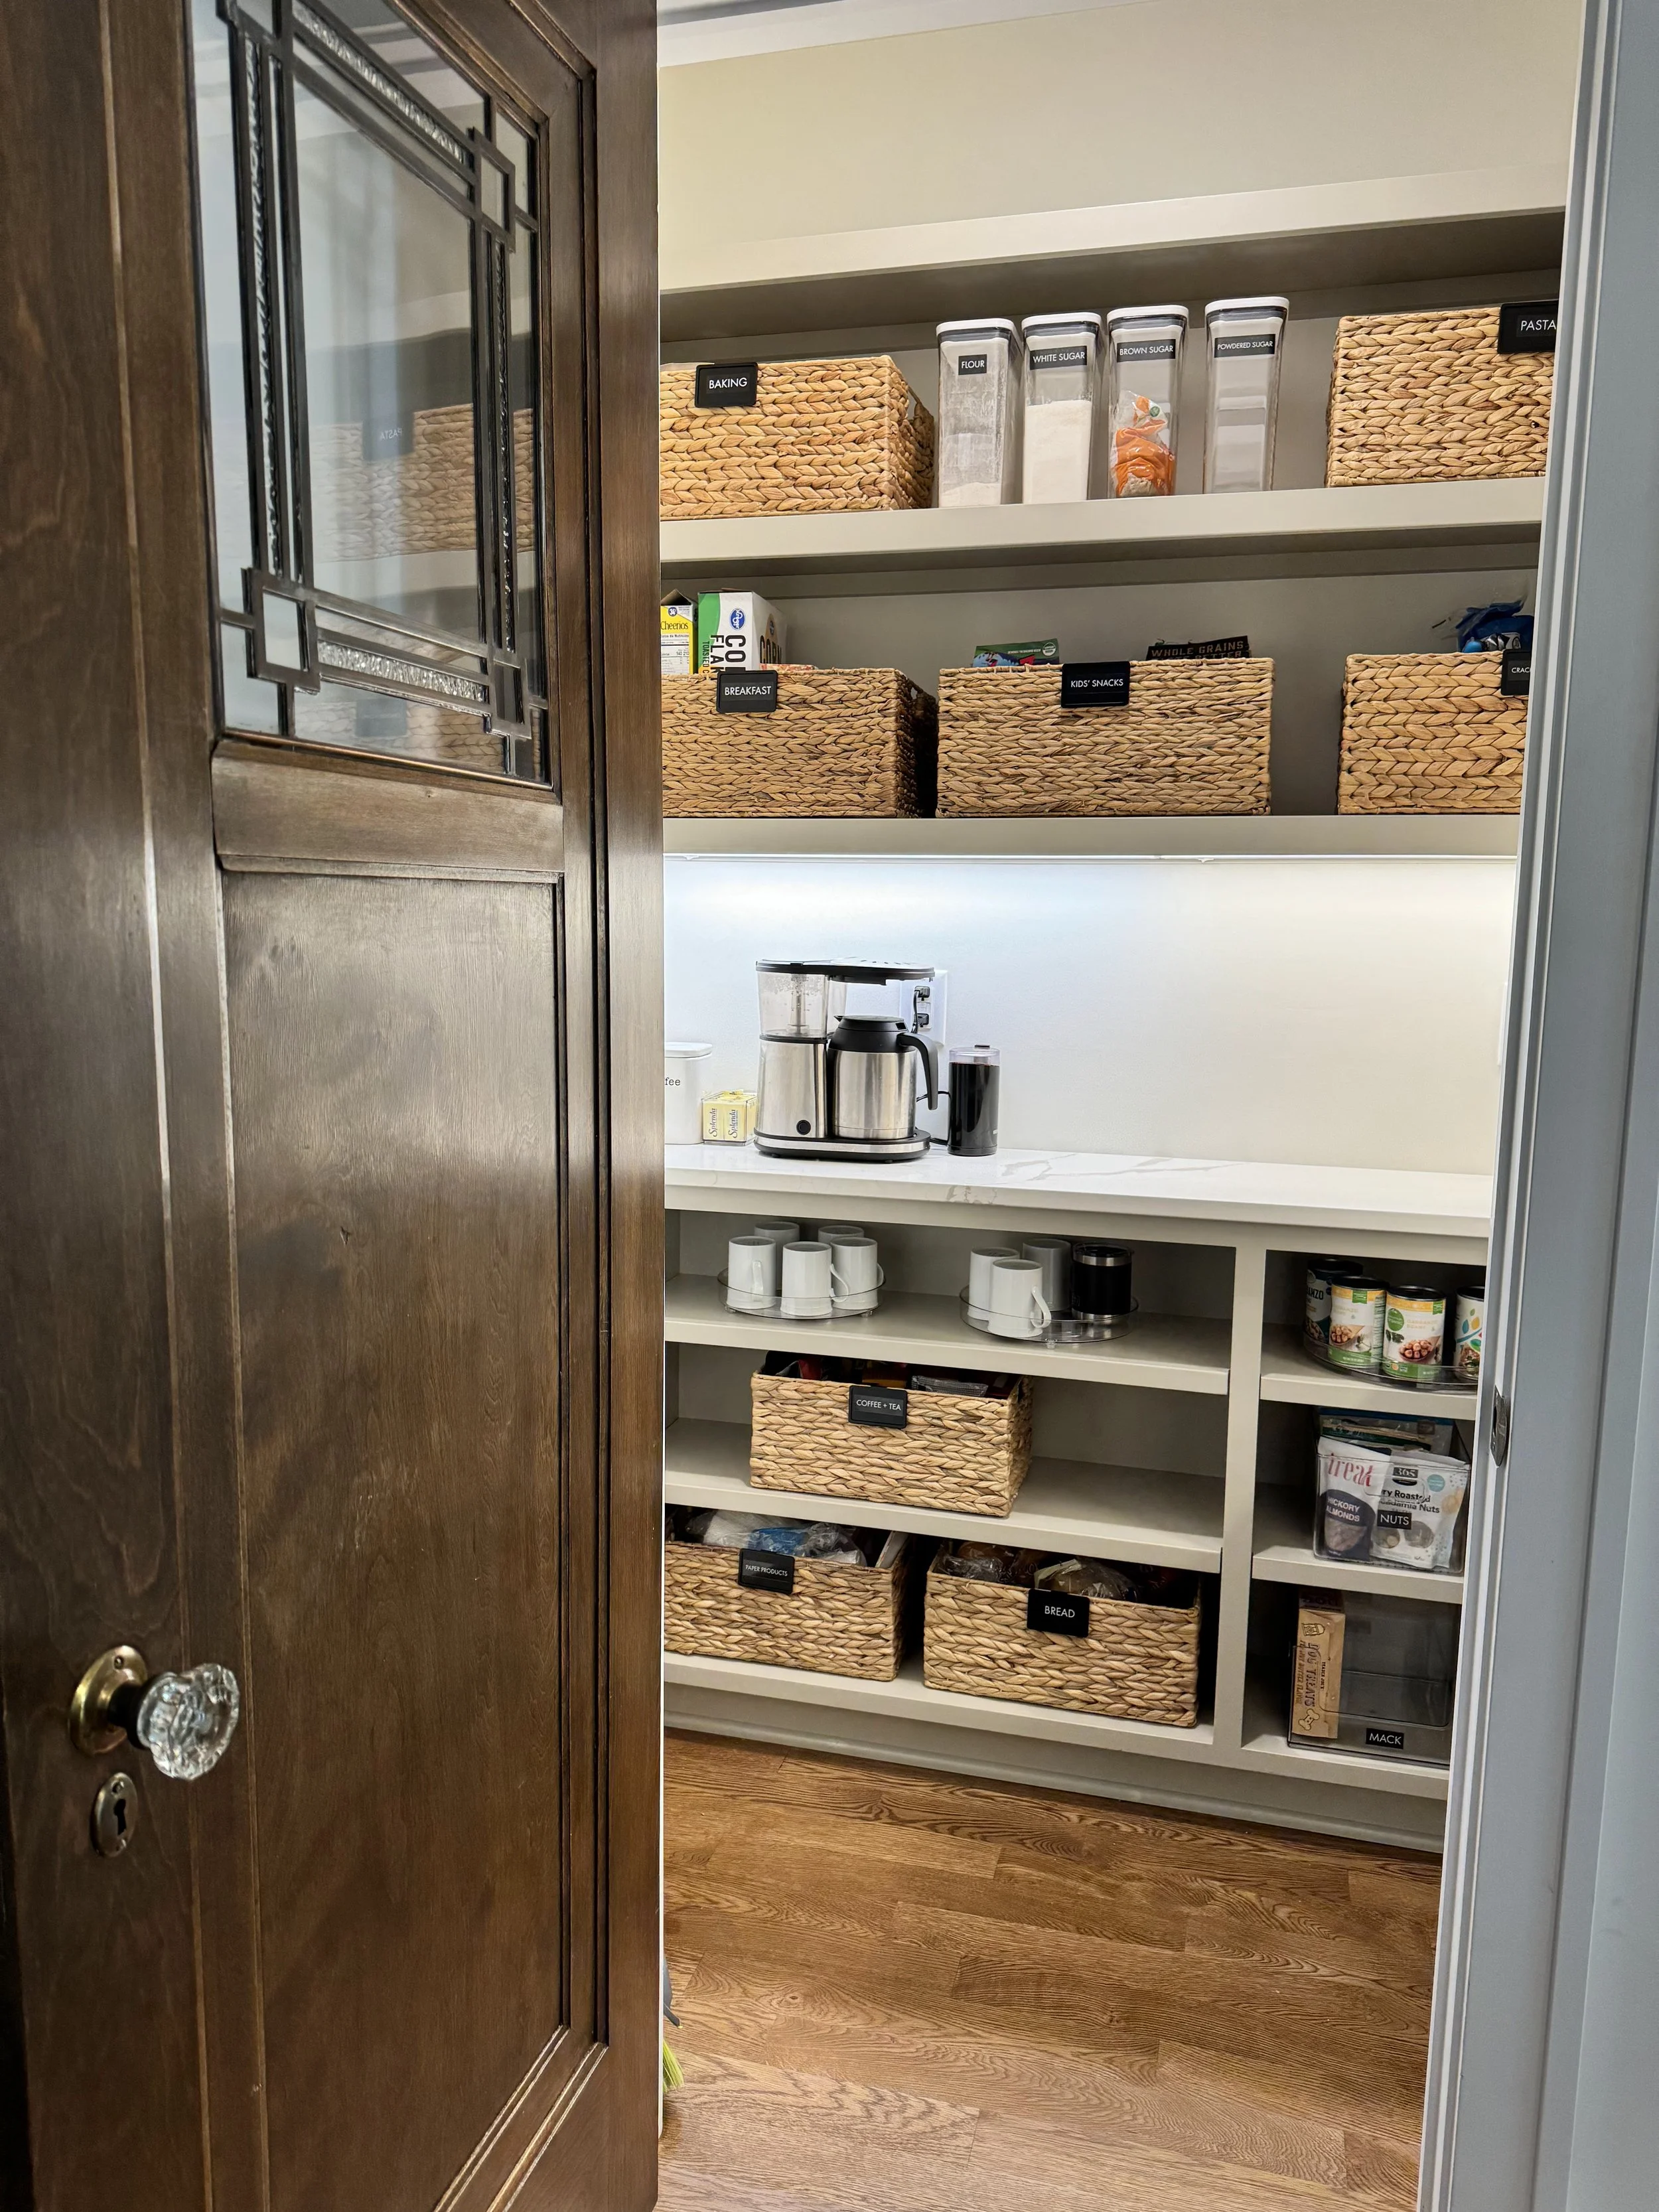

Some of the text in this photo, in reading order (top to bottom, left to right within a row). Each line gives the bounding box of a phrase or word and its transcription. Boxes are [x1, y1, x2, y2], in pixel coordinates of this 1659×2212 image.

[1520, 319, 1556, 331] PASTA
[1119, 344, 1174, 356] BROWN SUGAR
[1216, 341, 1251, 351] POWDERED
[1033, 351, 1086, 364] WHITE SUGAR
[961, 360, 985, 369] FLOUR
[709, 377, 748, 389] BAKING
[1151, 640, 1244, 658] WHOLE GRAINS
[1070, 678, 1123, 688] KIDS' SNACKS
[725, 686, 772, 696] BREAKFAST
[708, 1108, 718, 1138] Splenda
[728, 1109, 738, 1139] Splenda
[856, 1399, 882, 1408] COFFEE
[1327, 1496, 1360, 1512] HICKORY
[1419, 1504, 1440, 1514] Nuts
[1327, 1505, 1360, 1522] ALMONDS
[1380, 1514, 1409, 1526] NUTS
[760, 1567, 788, 1577] PRODUCTS
[1045, 1605, 1076, 1618] BREAD
[1369, 1732, 1402, 1745] MACK
